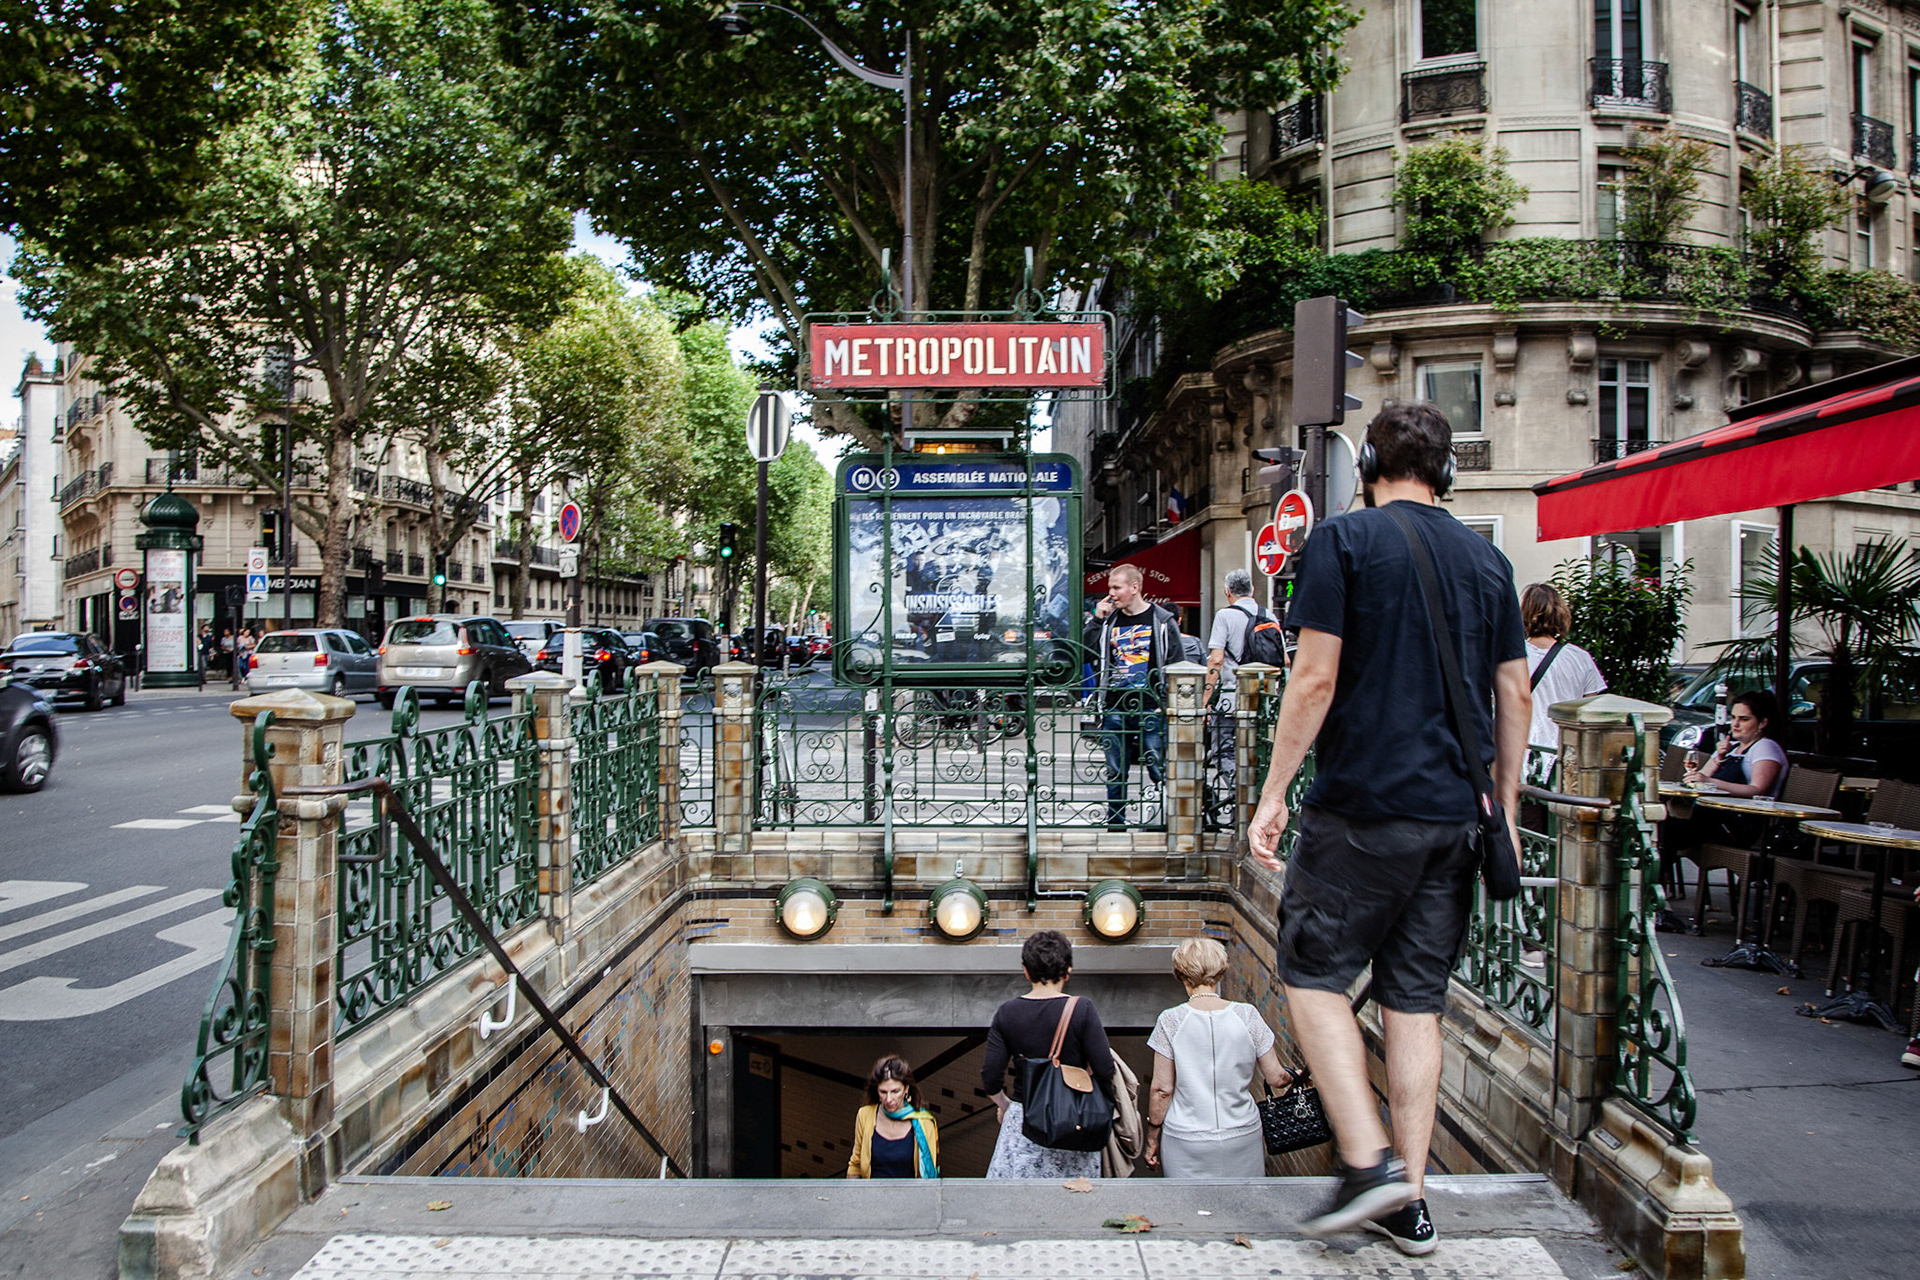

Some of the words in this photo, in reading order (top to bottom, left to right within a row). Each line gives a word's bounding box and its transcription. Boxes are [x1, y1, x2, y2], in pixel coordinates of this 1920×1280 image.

[824, 336, 1092, 376] METROPOLITAIN
[858, 473, 870, 485] M
[912, 471, 986, 484] ASSEMBLÉE
[989, 471, 1059, 483] NATIOALE
[922, 511, 944, 521] POUR
[944, 511, 957, 520] UN
[1148, 569, 1171, 584] STOP
